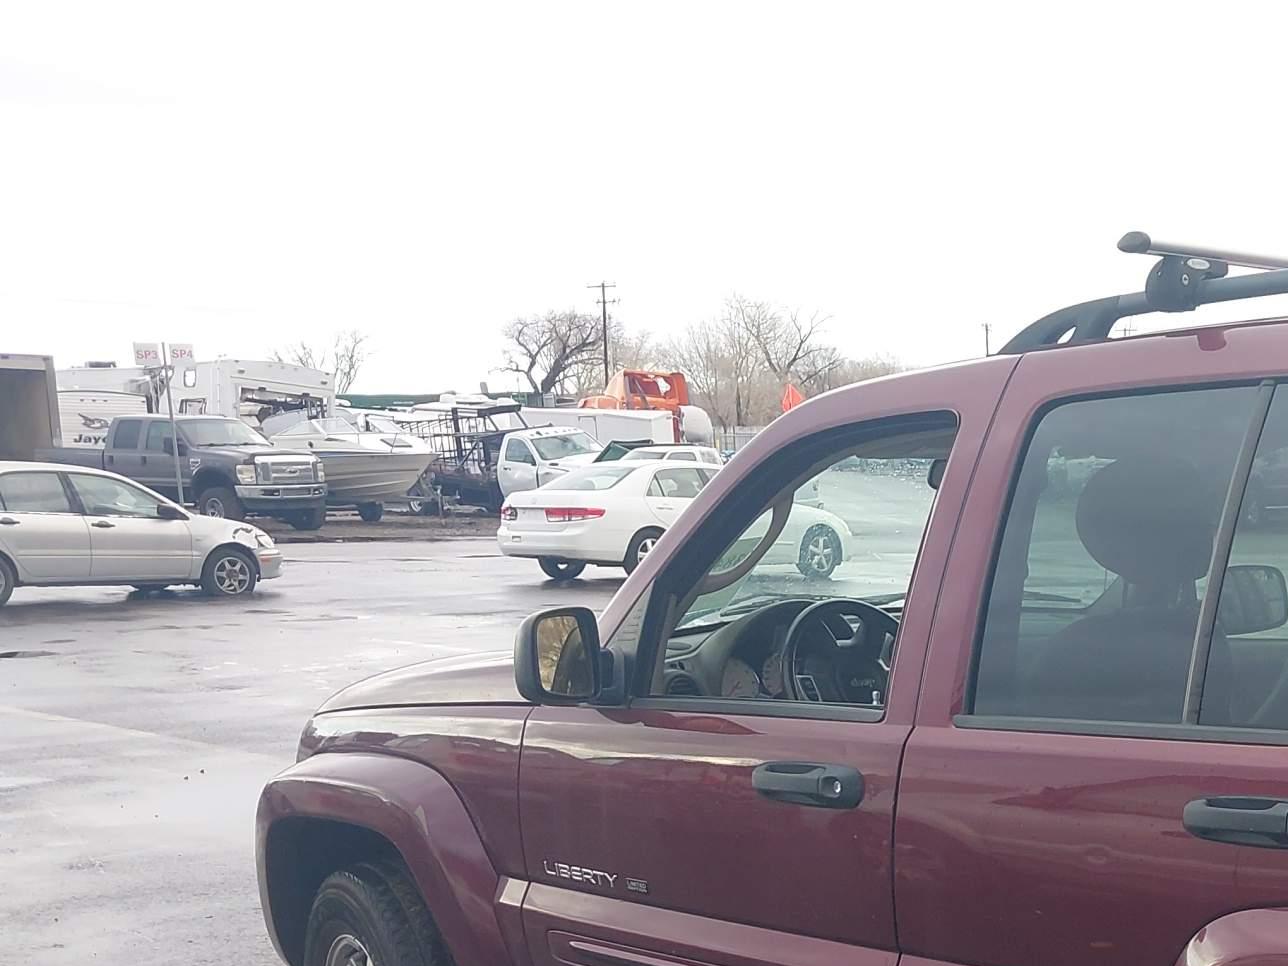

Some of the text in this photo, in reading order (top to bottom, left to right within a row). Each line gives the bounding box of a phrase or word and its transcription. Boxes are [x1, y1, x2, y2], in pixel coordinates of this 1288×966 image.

[136, 350, 158, 360] SP3
[171, 348, 193, 359] SP4
[543, 860, 618, 888] LIBERTY
